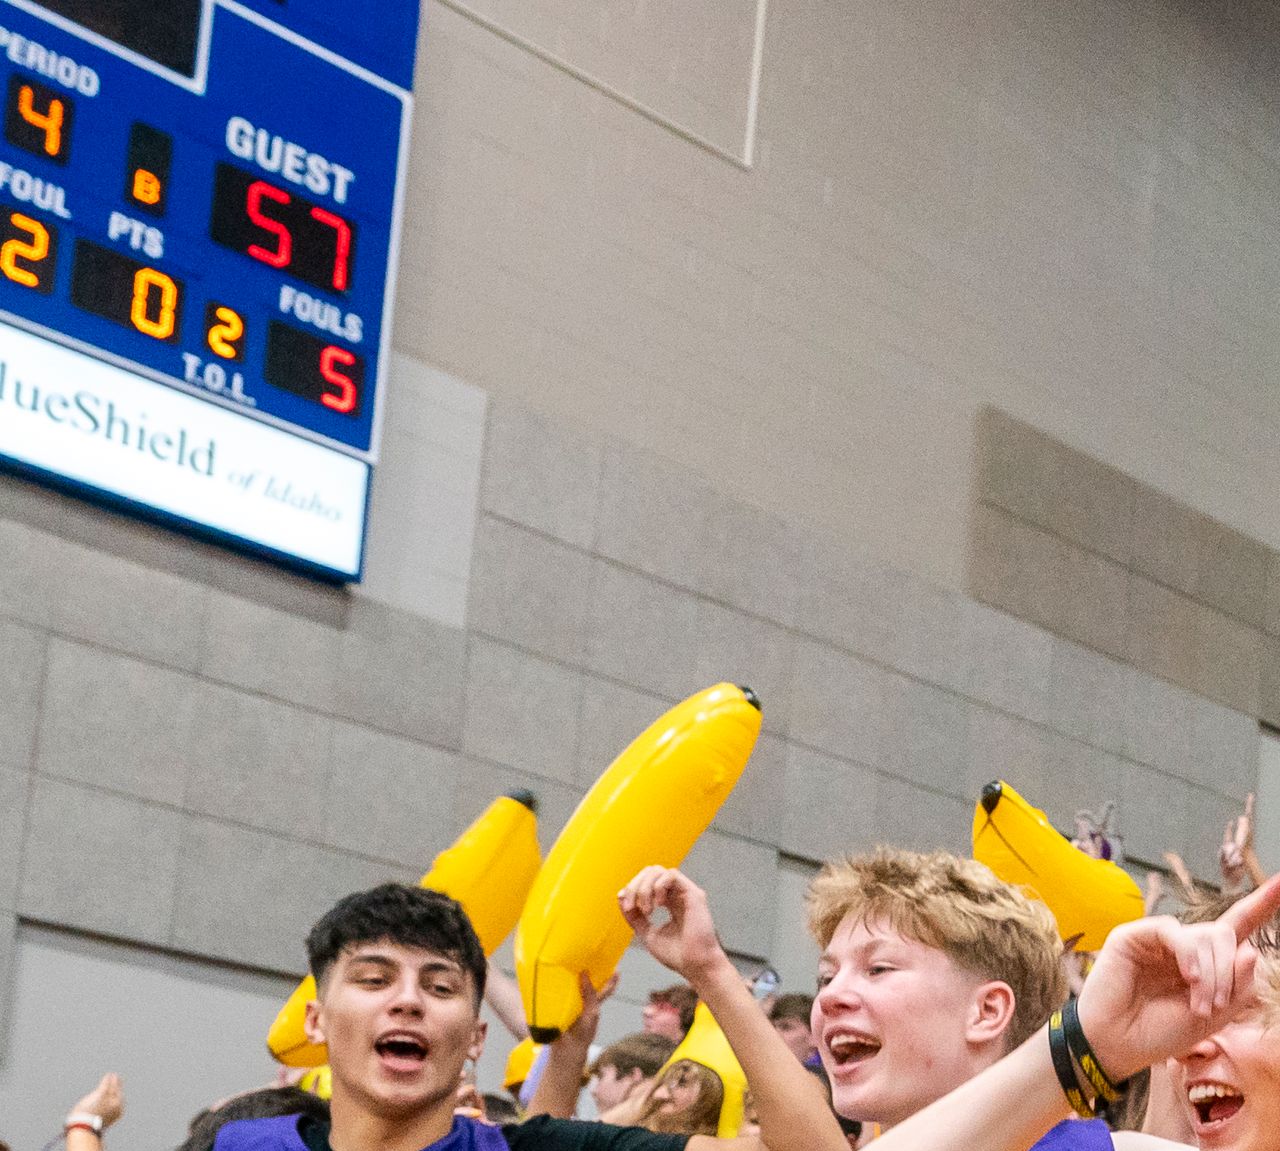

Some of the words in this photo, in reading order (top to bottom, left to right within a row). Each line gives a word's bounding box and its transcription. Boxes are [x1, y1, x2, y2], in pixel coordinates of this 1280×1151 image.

[18, 85, 64, 156] 4
[225, 116, 356, 205] GUEST
[0, 212, 49, 288] 2
[107, 211, 165, 259] PTS
[246, 180, 351, 291] 57
[131, 267, 178, 339] 0
[208, 307, 244, 359] 2
[279, 284, 363, 343] FOULS
[182, 352, 257, 407] T.O.L.
[320, 345, 357, 413] 5
[228, 469, 258, 490] of
[264, 475, 343, 522] Idaho
